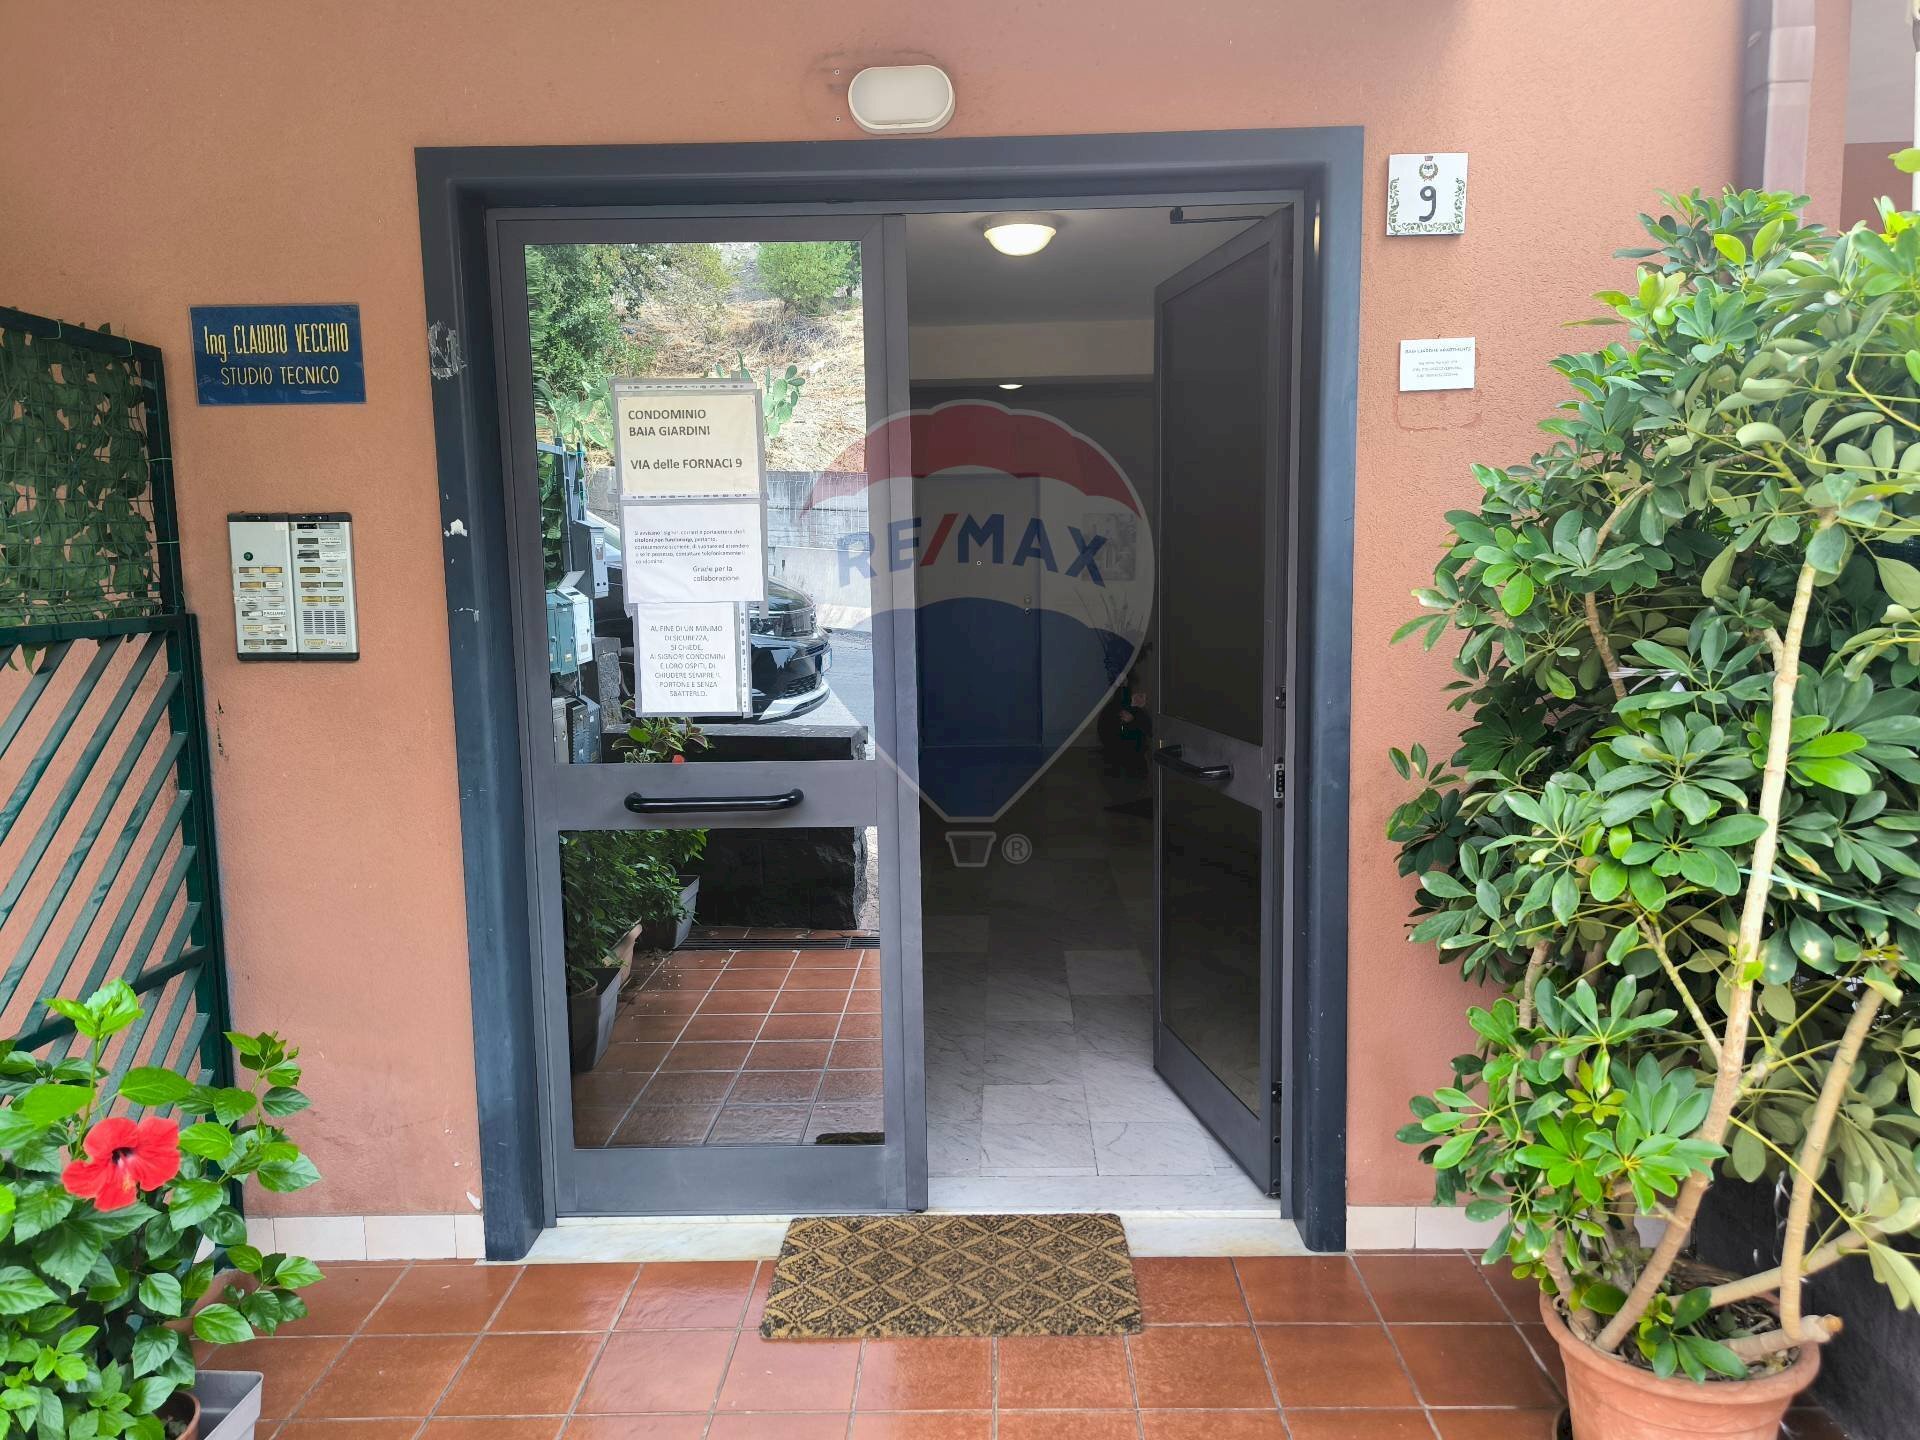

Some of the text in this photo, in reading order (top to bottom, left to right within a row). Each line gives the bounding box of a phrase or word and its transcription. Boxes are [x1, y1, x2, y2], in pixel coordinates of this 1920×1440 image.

[1419, 185, 1436, 222] 9
[204, 322, 349, 363] Ing. CLAUDIO VECCHIO
[221, 365, 339, 385] STUDIO TECNICO
[628, 409, 706, 420] CONDOMINIO
[629, 425, 710, 437] BAIA GIARDINI
[630, 458, 743, 470] VIA delle FORNACI 9
